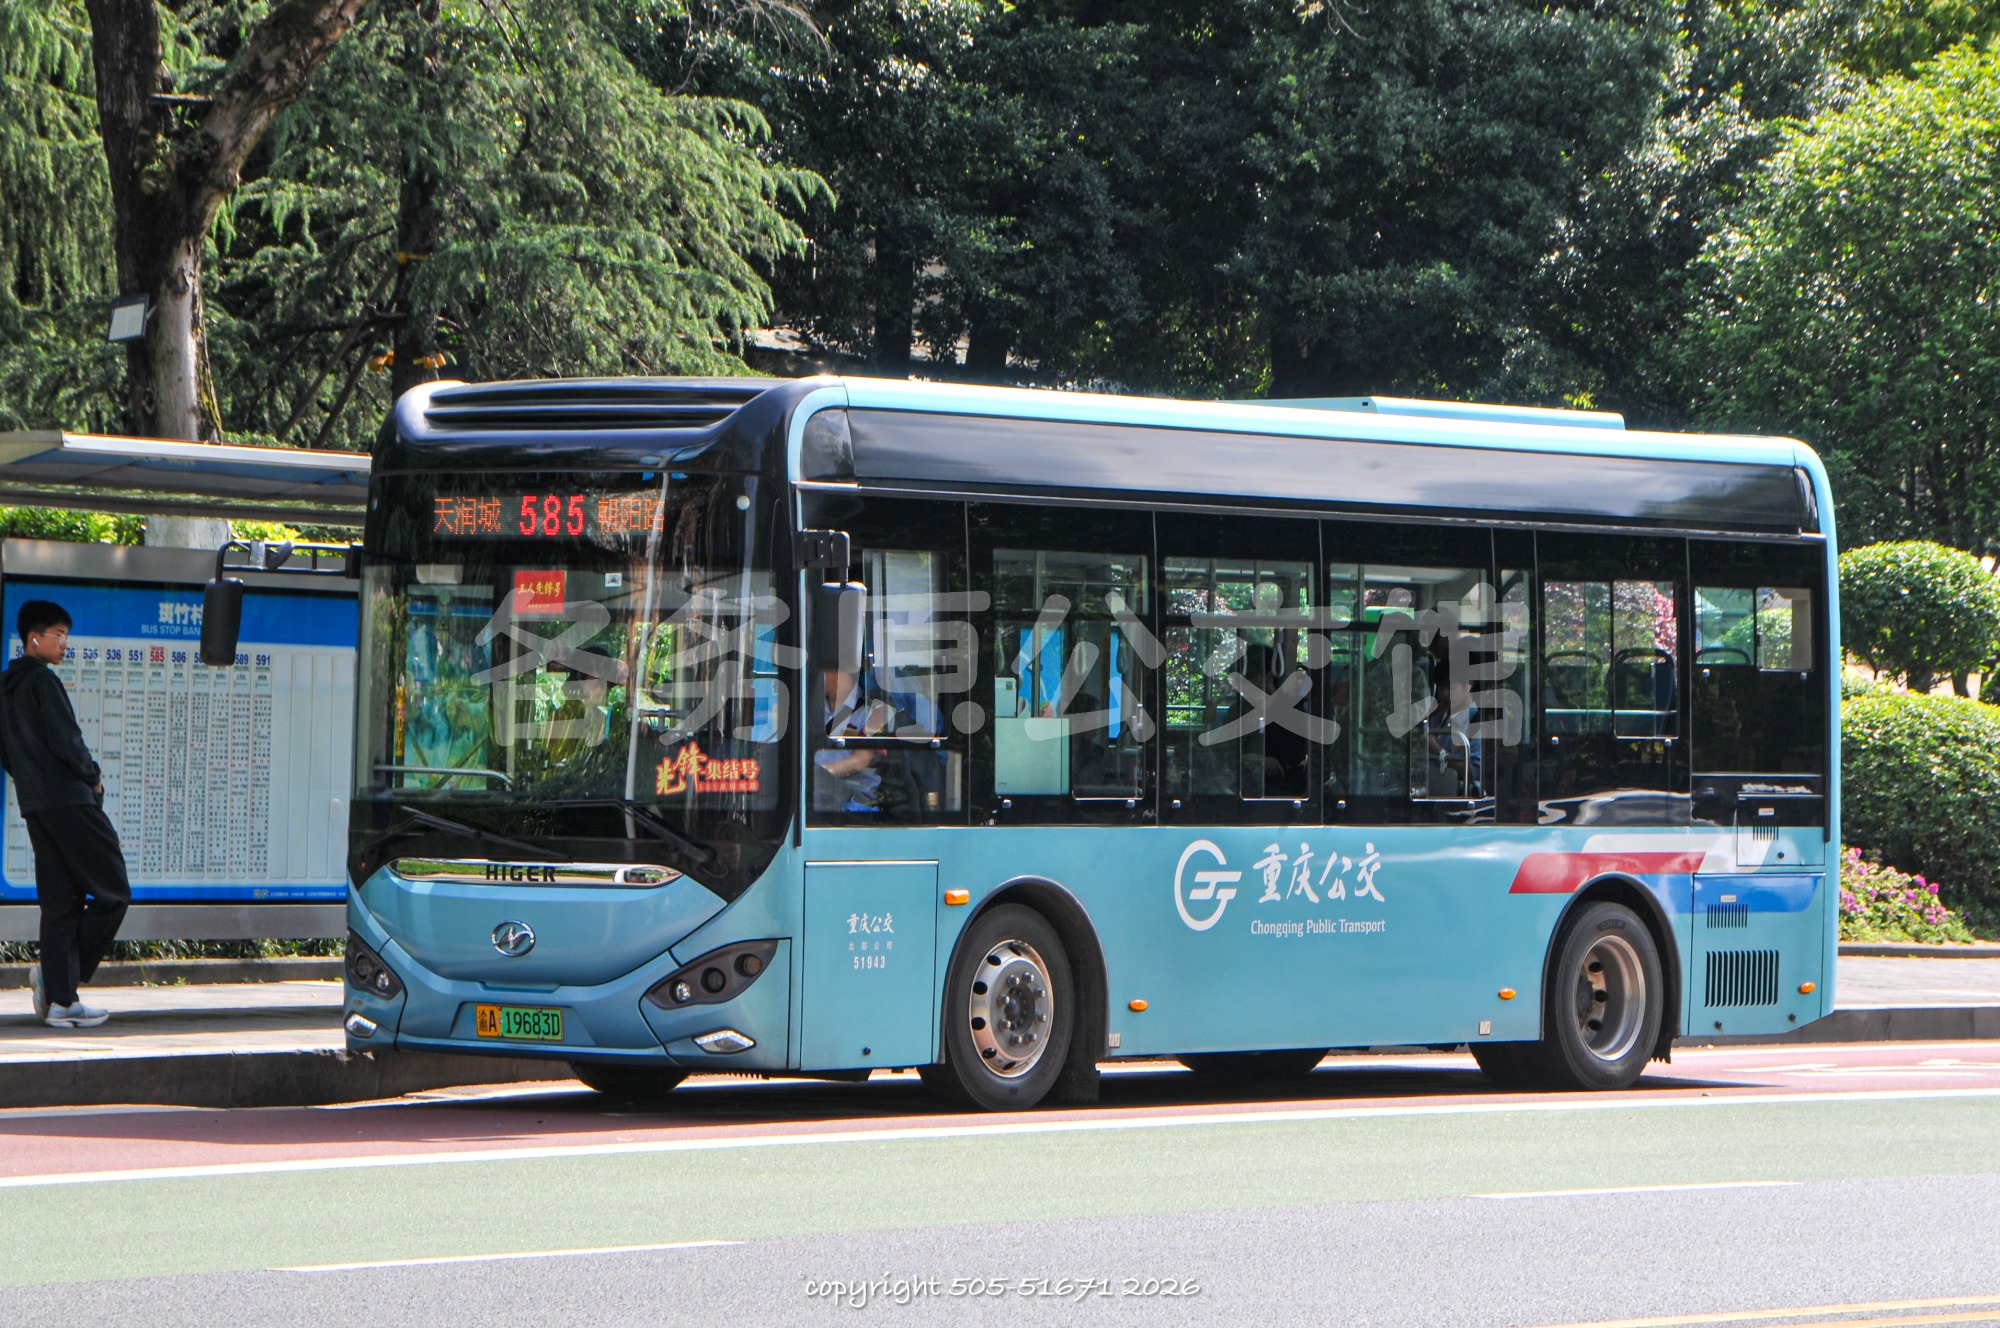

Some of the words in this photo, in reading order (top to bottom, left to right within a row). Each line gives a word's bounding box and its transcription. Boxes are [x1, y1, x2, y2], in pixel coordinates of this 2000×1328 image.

[433, 497, 501, 535] 天润城
[519, 495, 585, 536] 585
[597, 497, 665, 535] 朝阳路
[141, 624, 158, 635] BUS
[160, 625, 181, 636] STOP
[106, 648, 122, 661] 536
[128, 649, 143, 662] 551
[149, 650, 165, 663] 585
[171, 651, 187, 664] 586
[255, 654, 271, 667] 591
[486, 863, 556, 883] HIGER
[1253, 842, 1385, 903] 重庆公交
[846, 912, 895, 934] 重庆公交
[1250, 918, 1304, 938] Chongqing
[1306, 918, 1337, 934] Public
[1339, 917, 1386, 935] Transport
[854, 955, 886, 970] 51943
